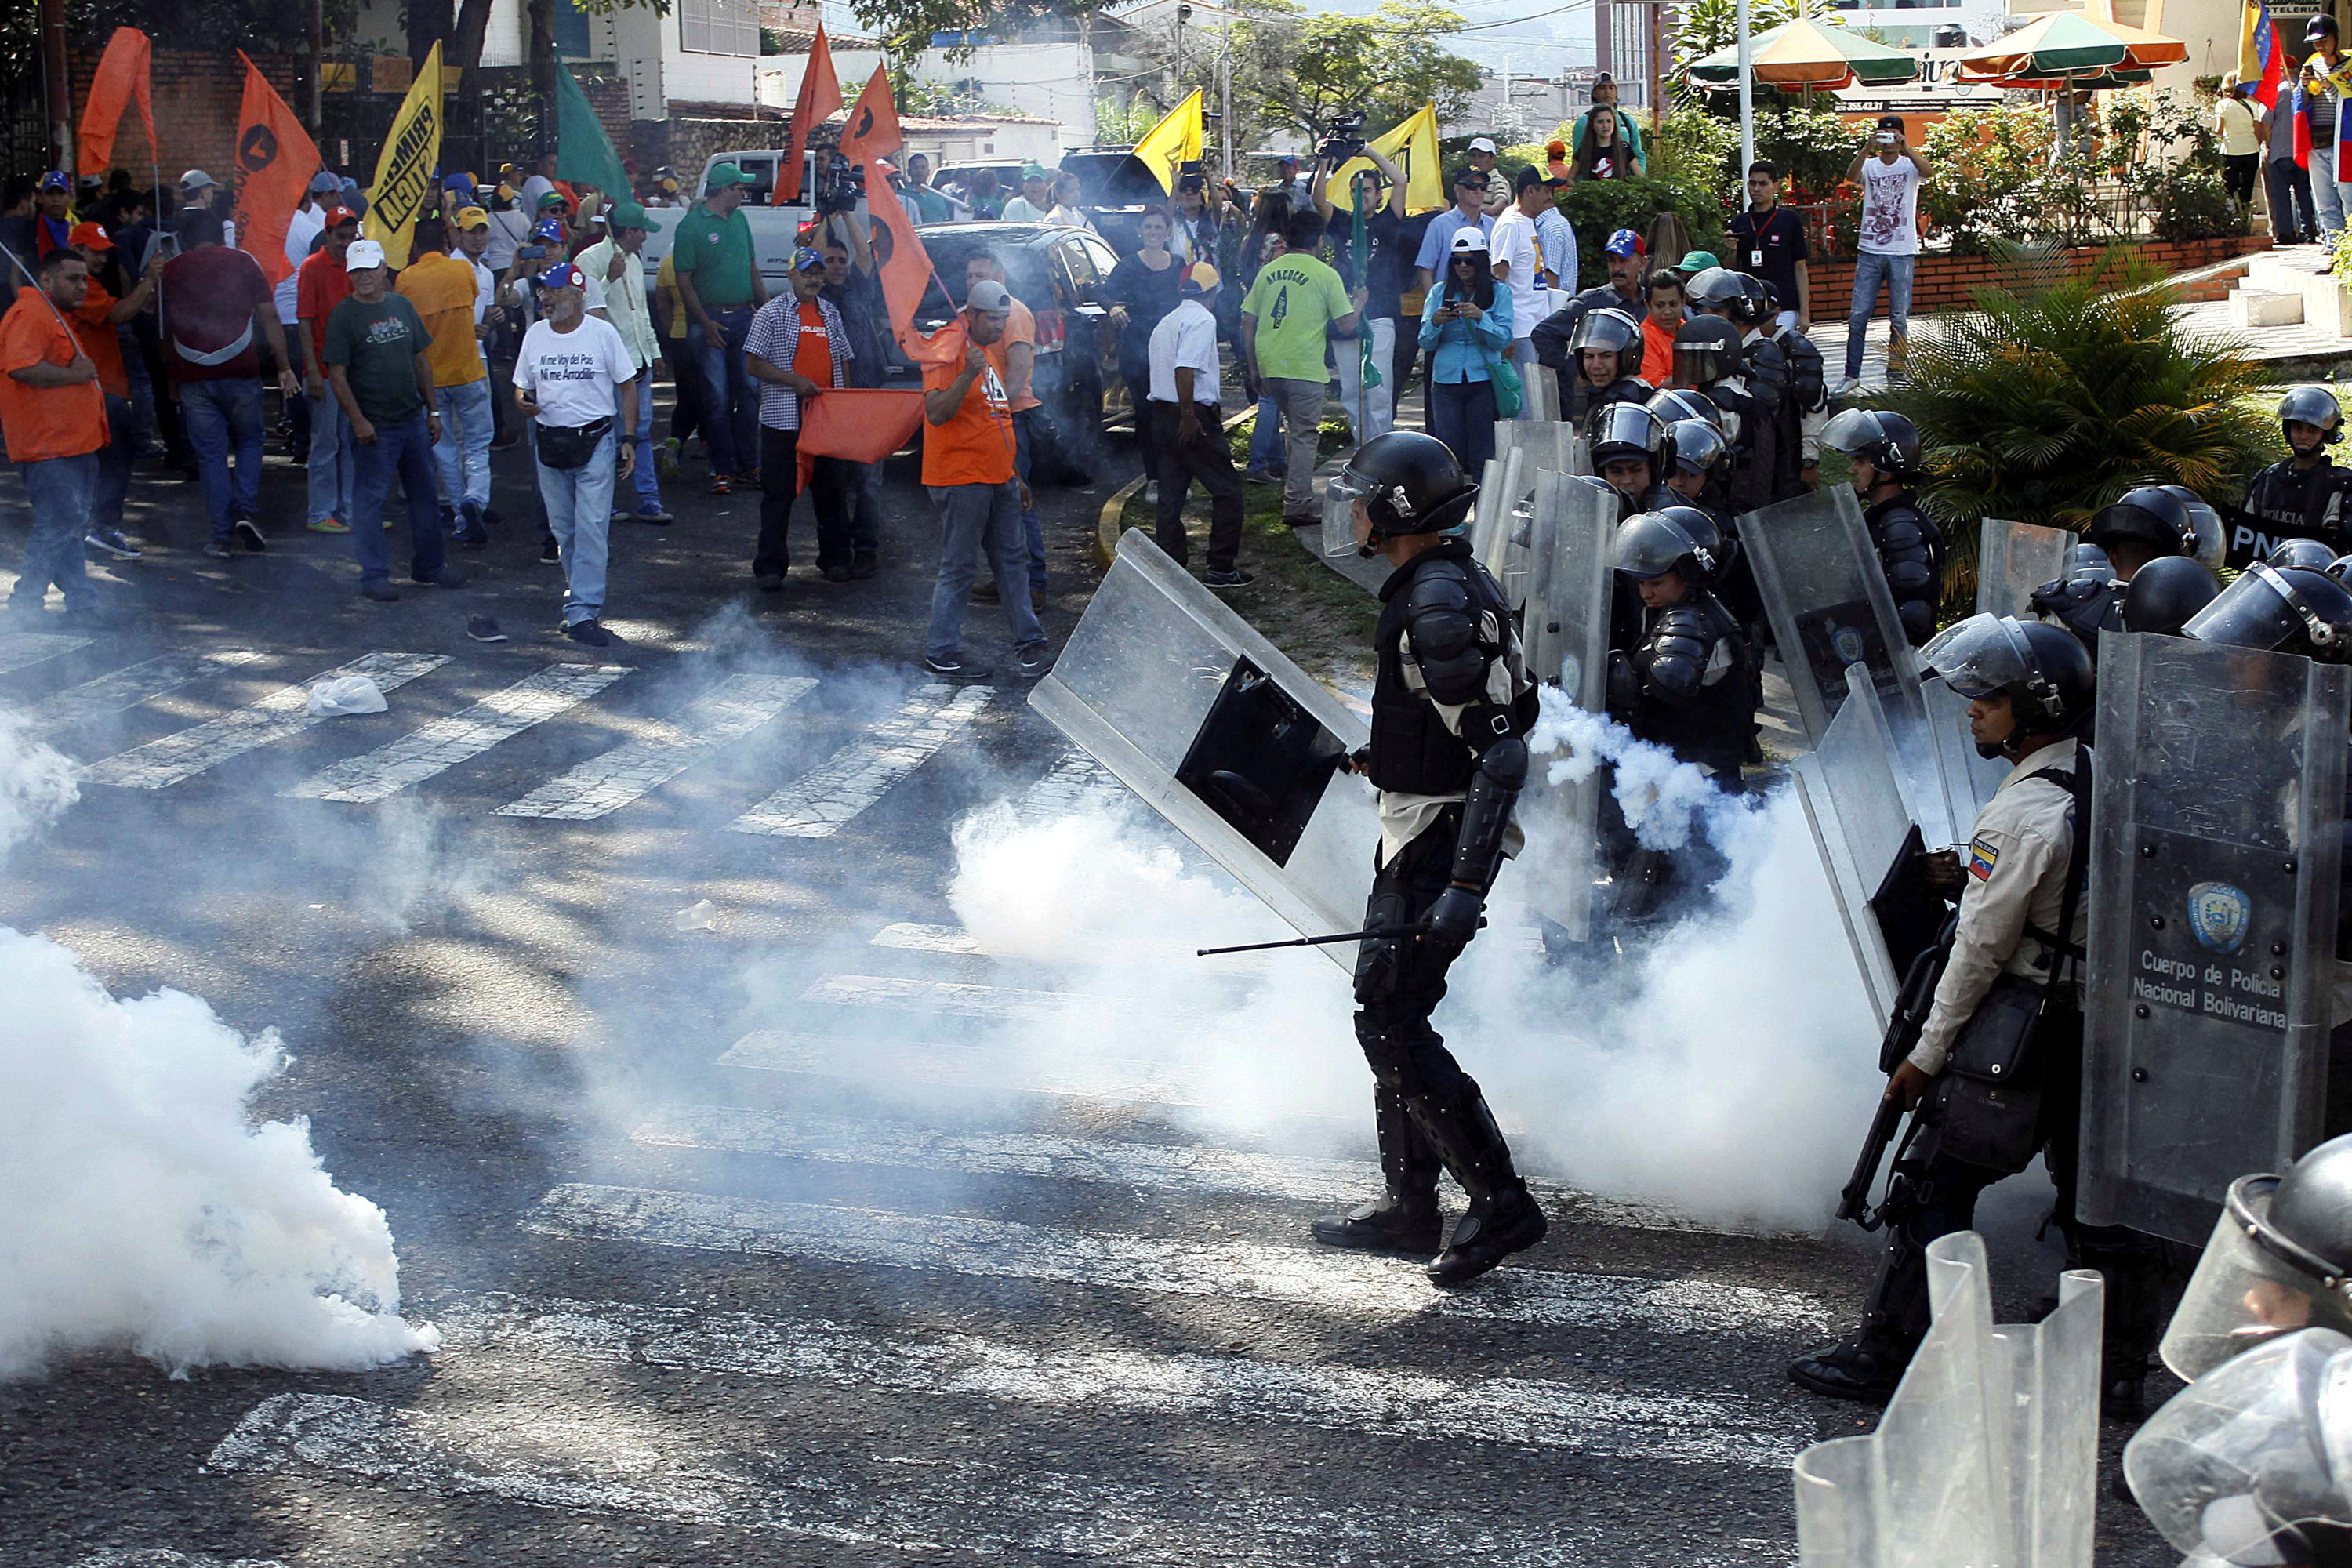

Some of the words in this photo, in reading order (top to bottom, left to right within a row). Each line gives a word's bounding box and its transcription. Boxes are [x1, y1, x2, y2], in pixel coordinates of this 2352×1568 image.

[1266, 270, 1309, 286] AYACUCHO
[1275, 296, 1287, 328] COPEI
[546, 357, 557, 365] me
[557, 354, 569, 368] Voy
[570, 354, 579, 365] del
[539, 369, 549, 381] Ni
[551, 370, 562, 381] me
[2262, 510, 2305, 526] POLICIA
[2232, 524, 2288, 559] PN
[2141, 949, 2195, 981] Cuerpo
[2204, 964, 2223, 985] de
[2133, 976, 2195, 1009] Nacional
[2203, 991, 2286, 1029] Bolivariana
